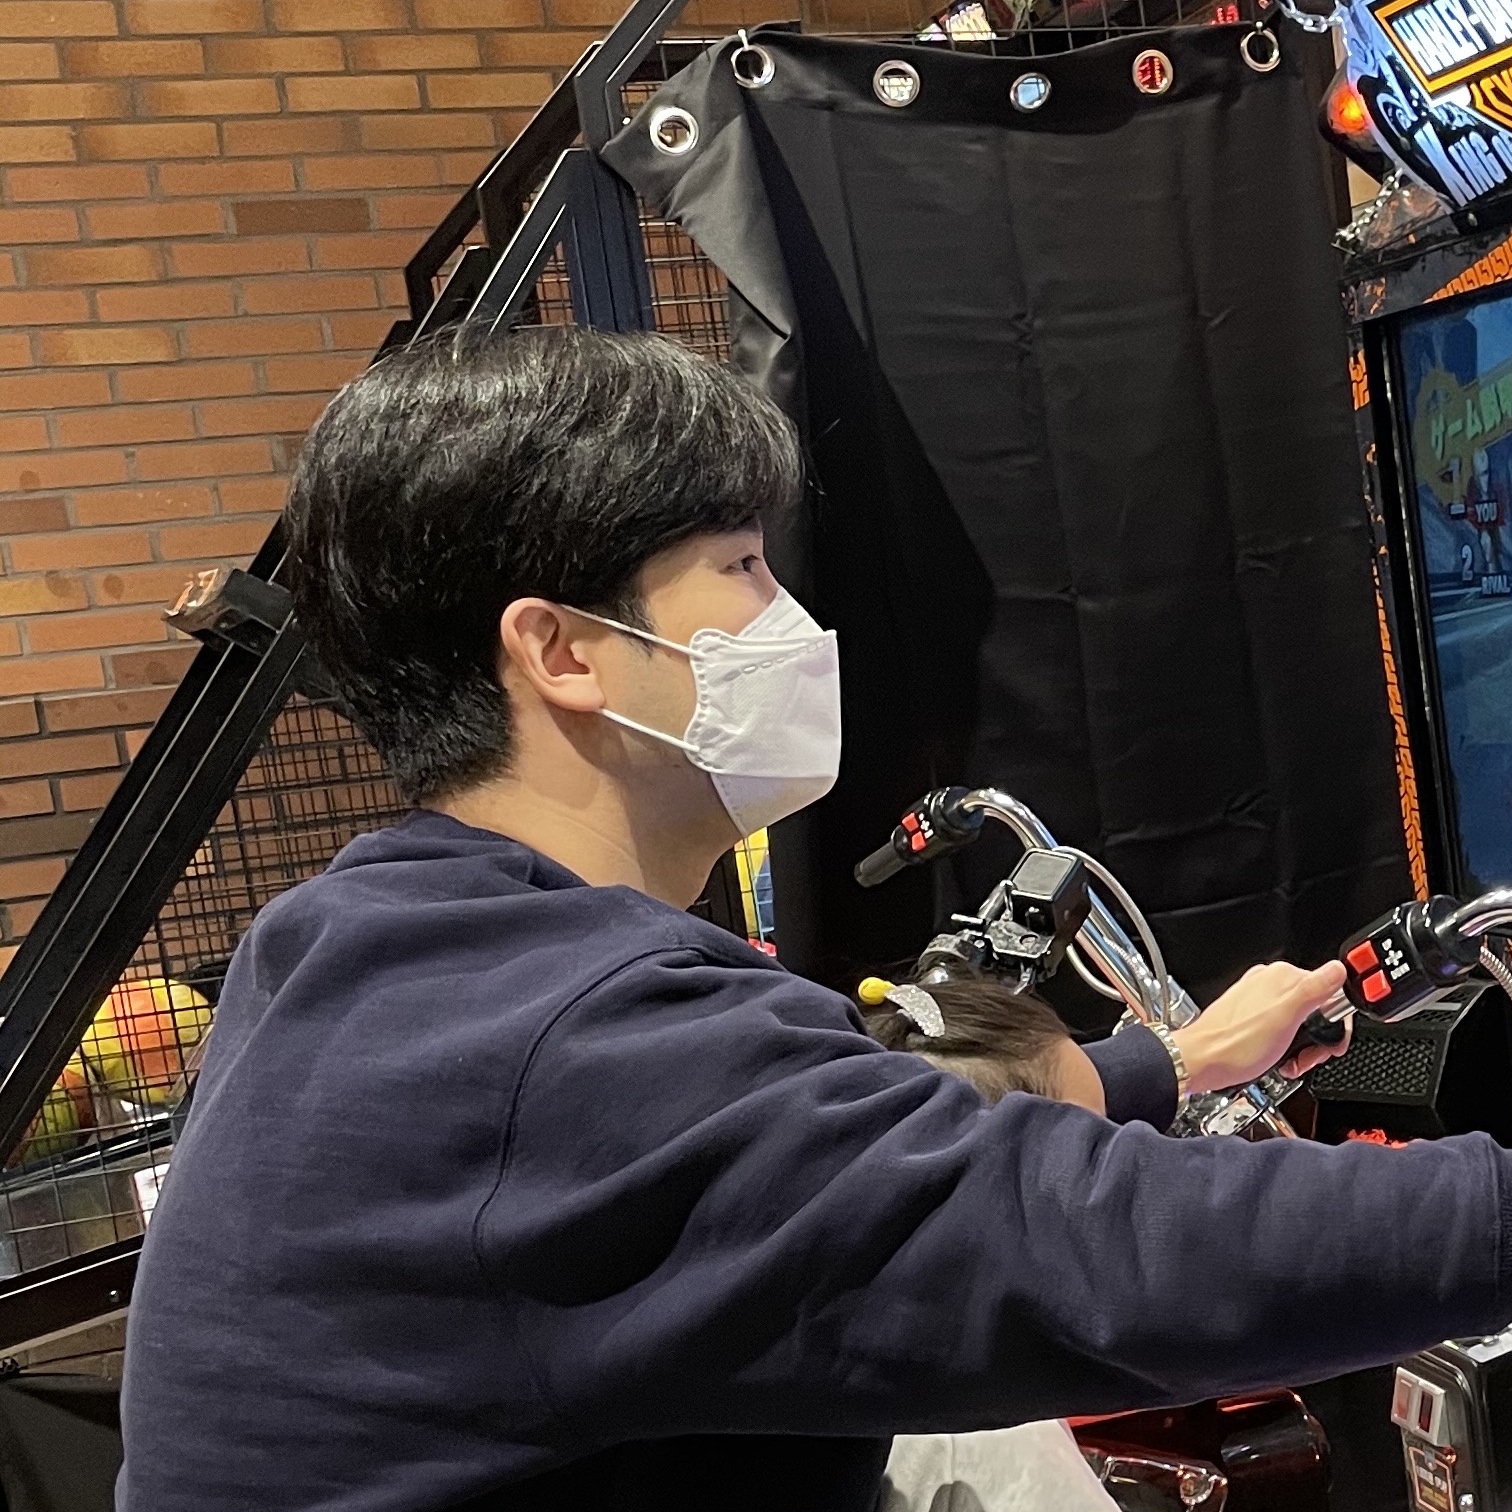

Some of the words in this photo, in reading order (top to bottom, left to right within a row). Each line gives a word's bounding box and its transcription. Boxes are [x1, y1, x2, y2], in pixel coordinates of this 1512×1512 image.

[1414, 120, 1507, 207] KING
[1475, 502, 1498, 523] YOU
[1461, 544, 1474, 581] 2
[1482, 575, 1511, 595] RIVAL
